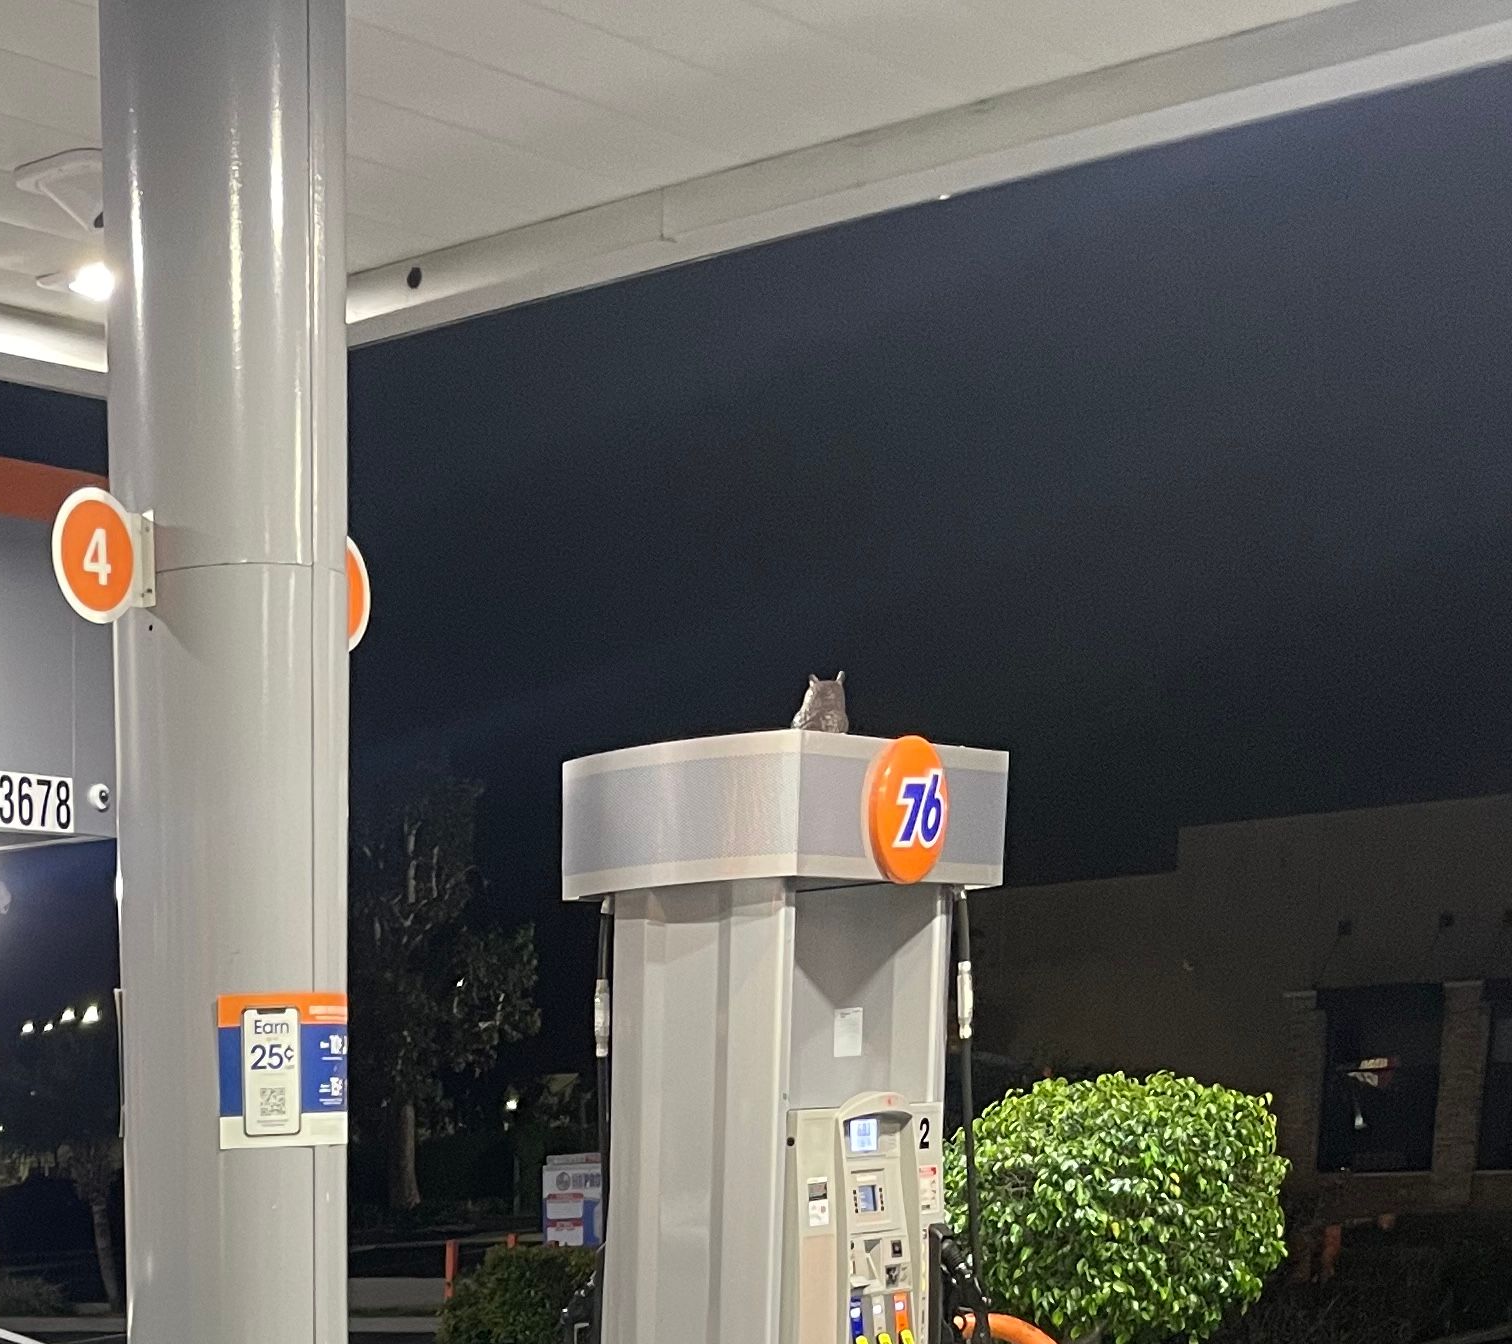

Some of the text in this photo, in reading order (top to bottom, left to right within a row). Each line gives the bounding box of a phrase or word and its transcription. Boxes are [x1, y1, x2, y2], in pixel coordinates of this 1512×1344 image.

[83, 528, 112, 586] 4
[891, 768, 943, 849] 76
[254, 1019, 290, 1035] Earn
[250, 1043, 295, 1071] 25¢
[919, 1117, 930, 1149] 2
